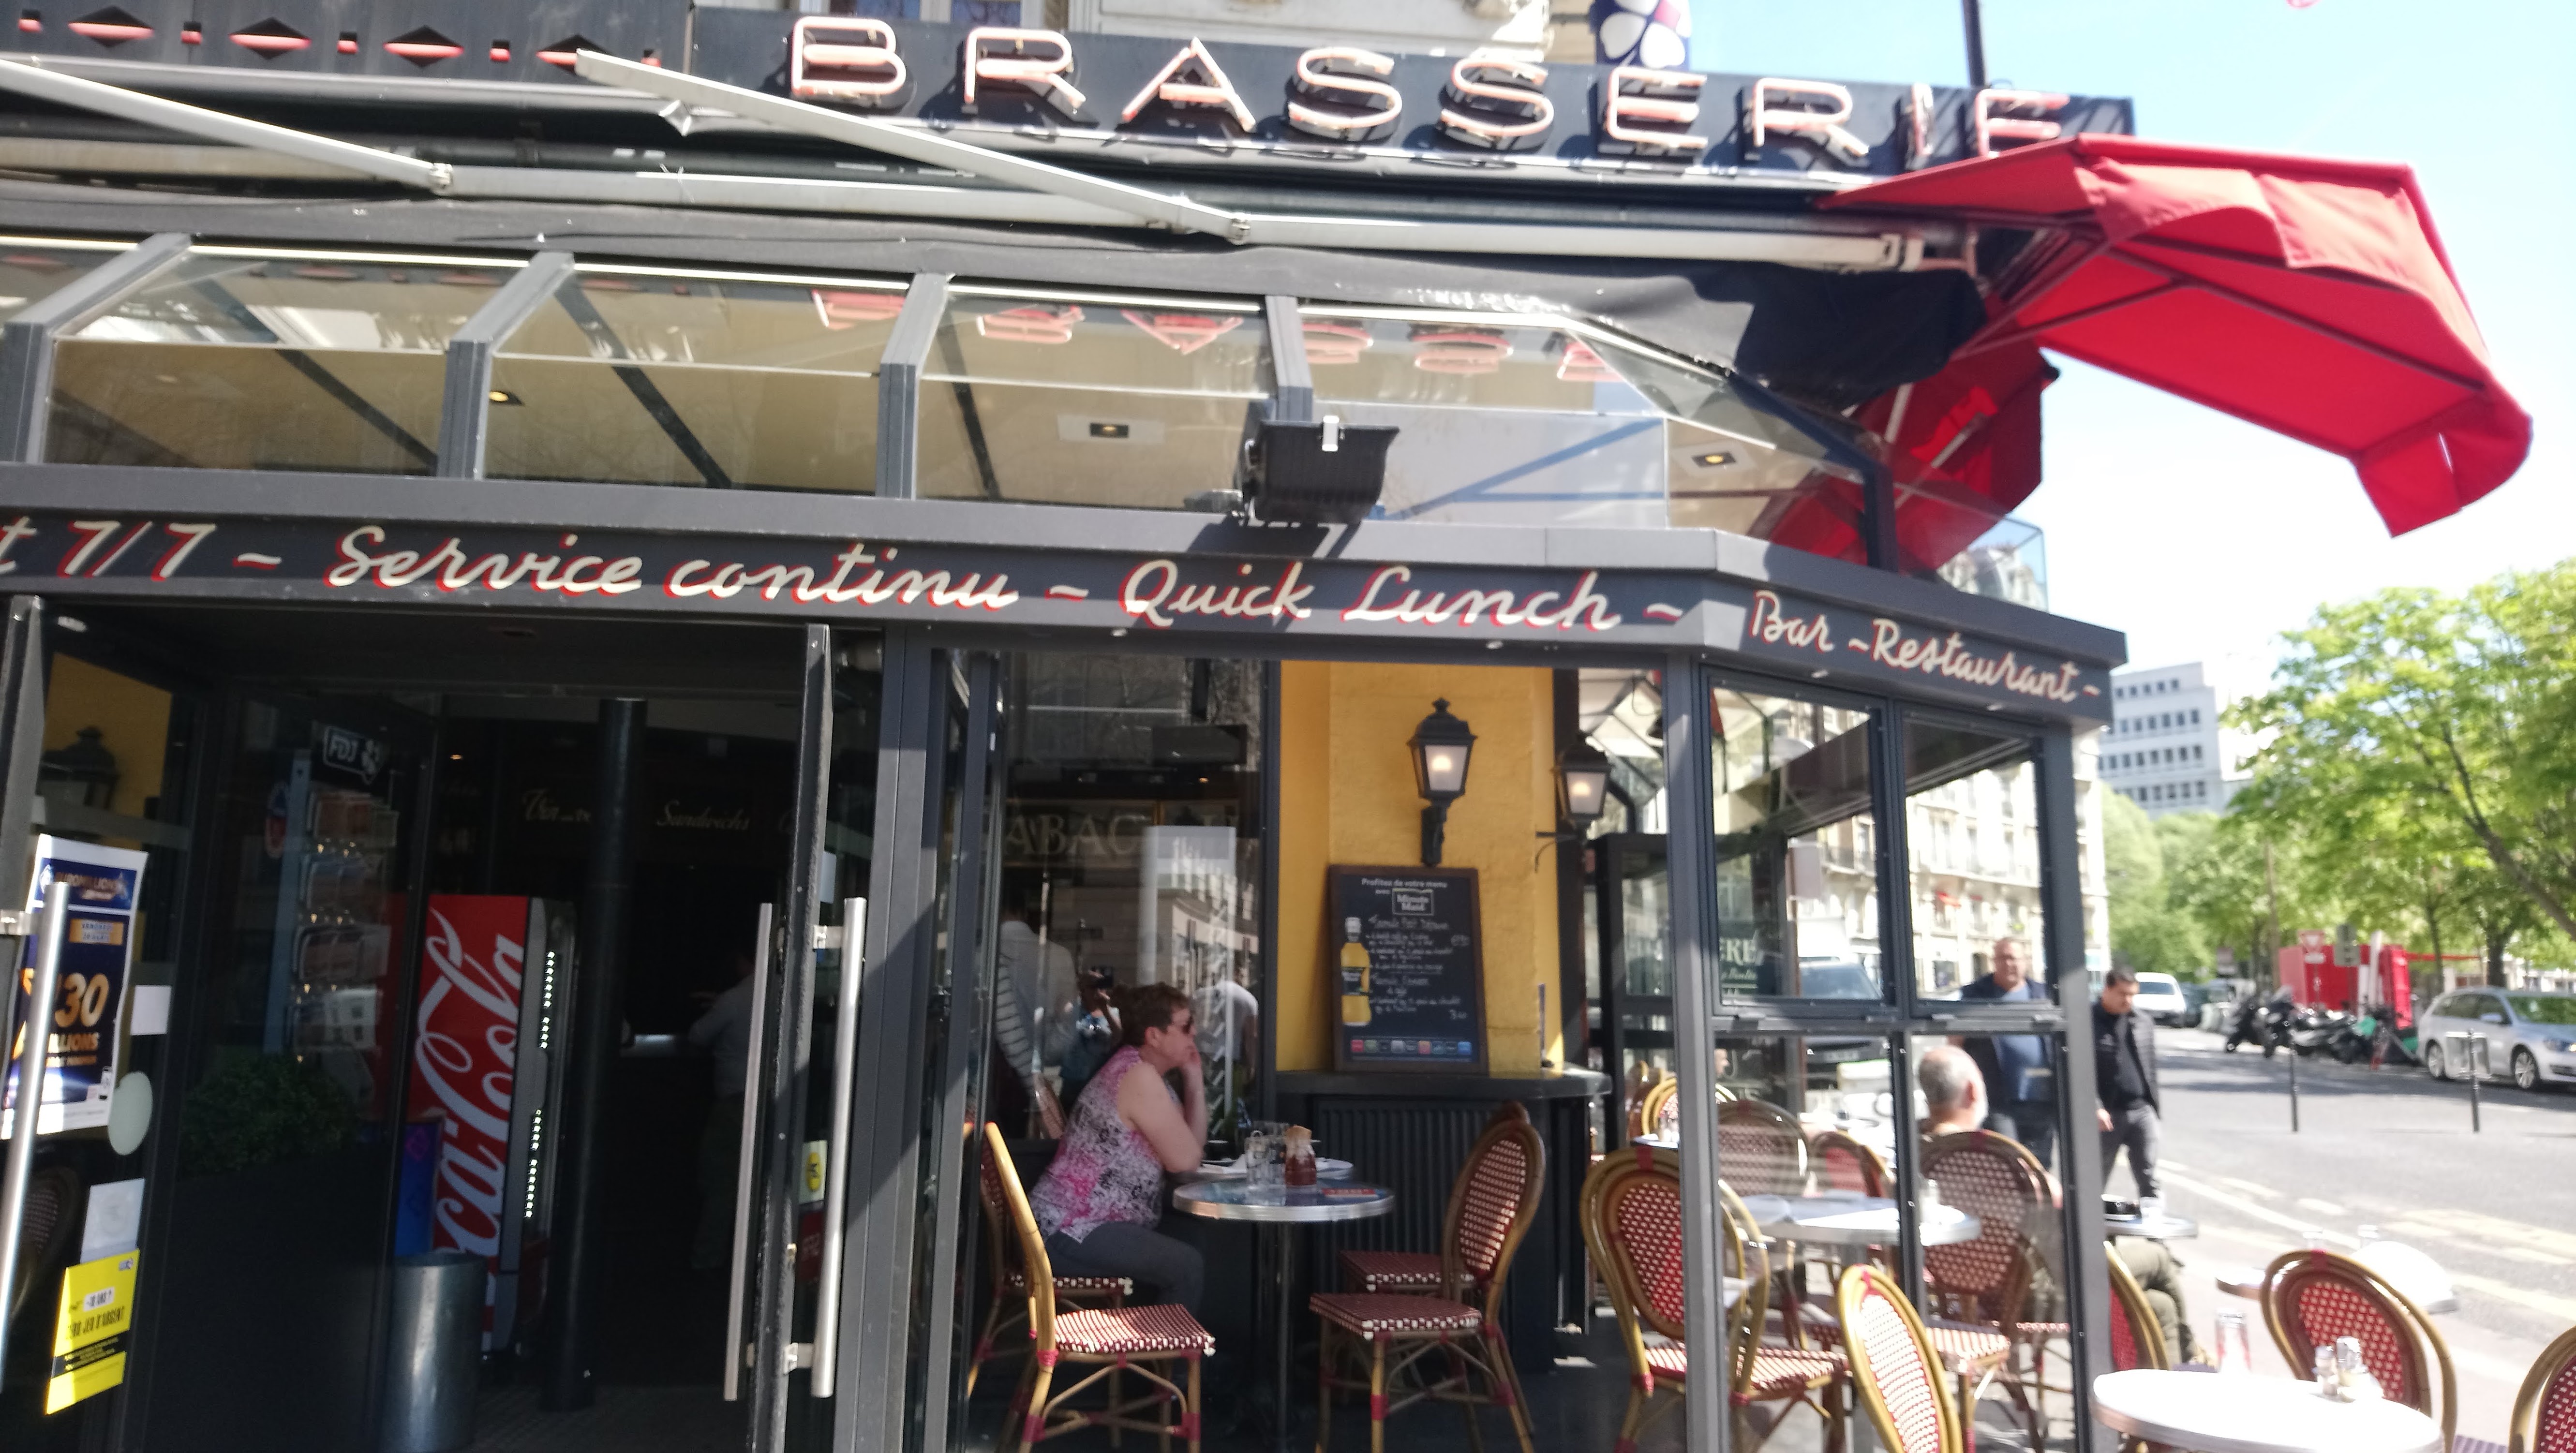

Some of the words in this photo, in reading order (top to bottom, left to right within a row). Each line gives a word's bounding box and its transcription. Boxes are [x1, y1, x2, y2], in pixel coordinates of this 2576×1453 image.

[56, 520, 217, 581] 7/7
[324, 525, 642, 597] Service
[664, 543, 1020, 612] continu
[1118, 559, 1314, 632] Quick
[1338, 565, 1622, 632] Lunch
[1748, 589, 1833, 653] Bar
[1003, 812, 1147, 856] ABAC
[55, 972, 110, 1027] 30
